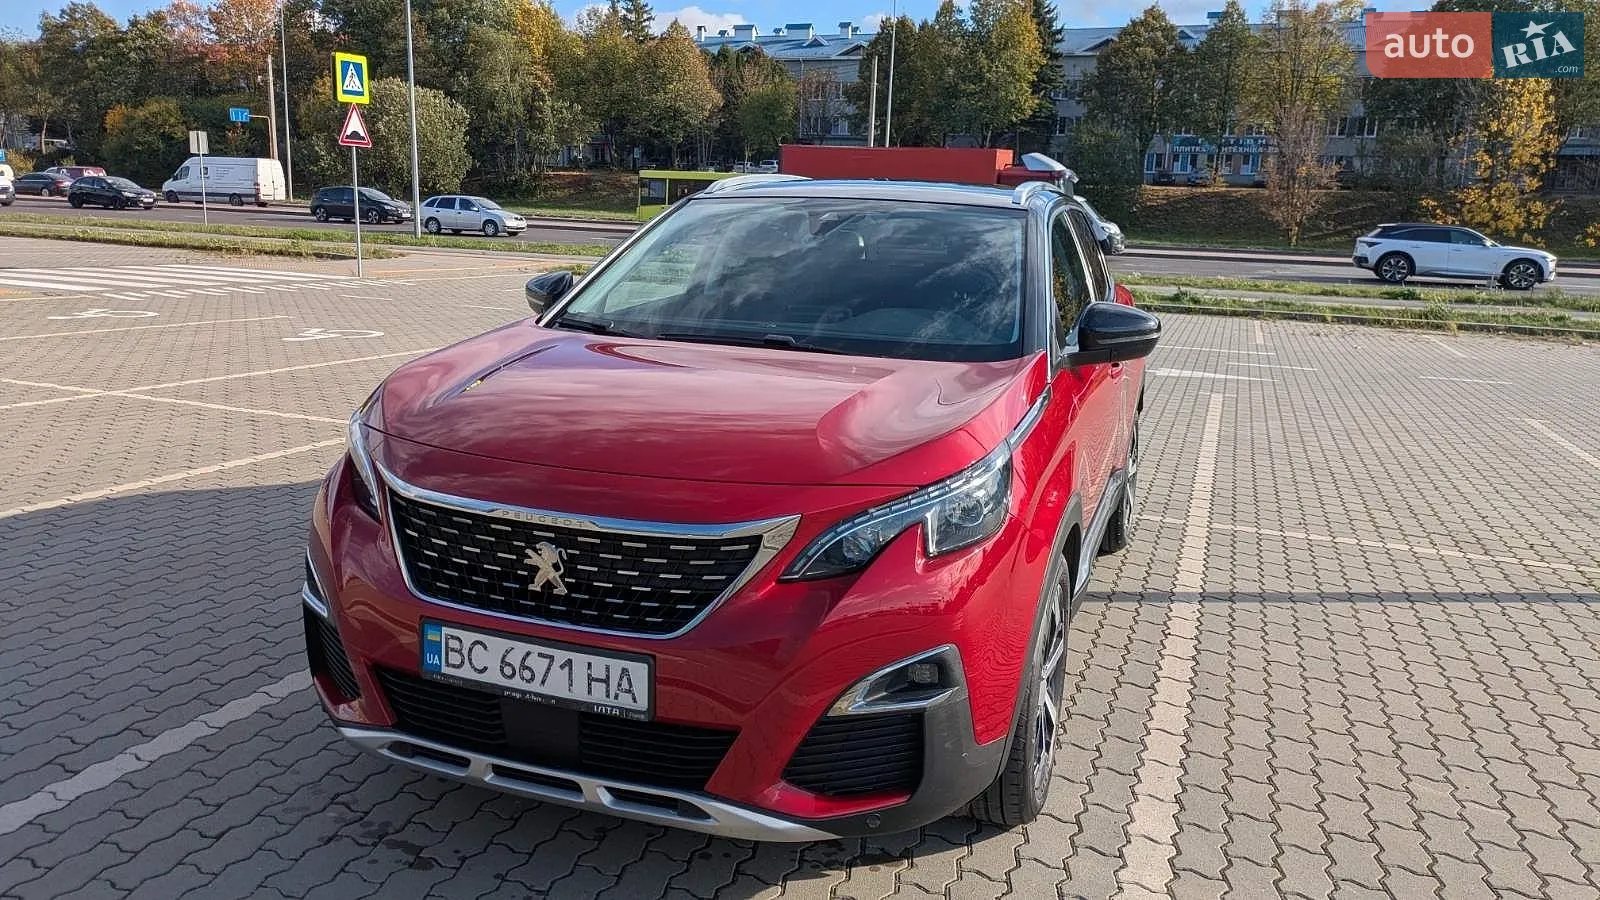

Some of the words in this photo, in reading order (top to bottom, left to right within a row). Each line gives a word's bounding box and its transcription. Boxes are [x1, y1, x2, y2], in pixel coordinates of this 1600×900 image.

[501, 509, 586, 528] PEUGEOT
[426, 652, 441, 666] UA
[444, 632, 489, 675] BC
[499, 646, 574, 694] 6671
[586, 661, 638, 704] HA
